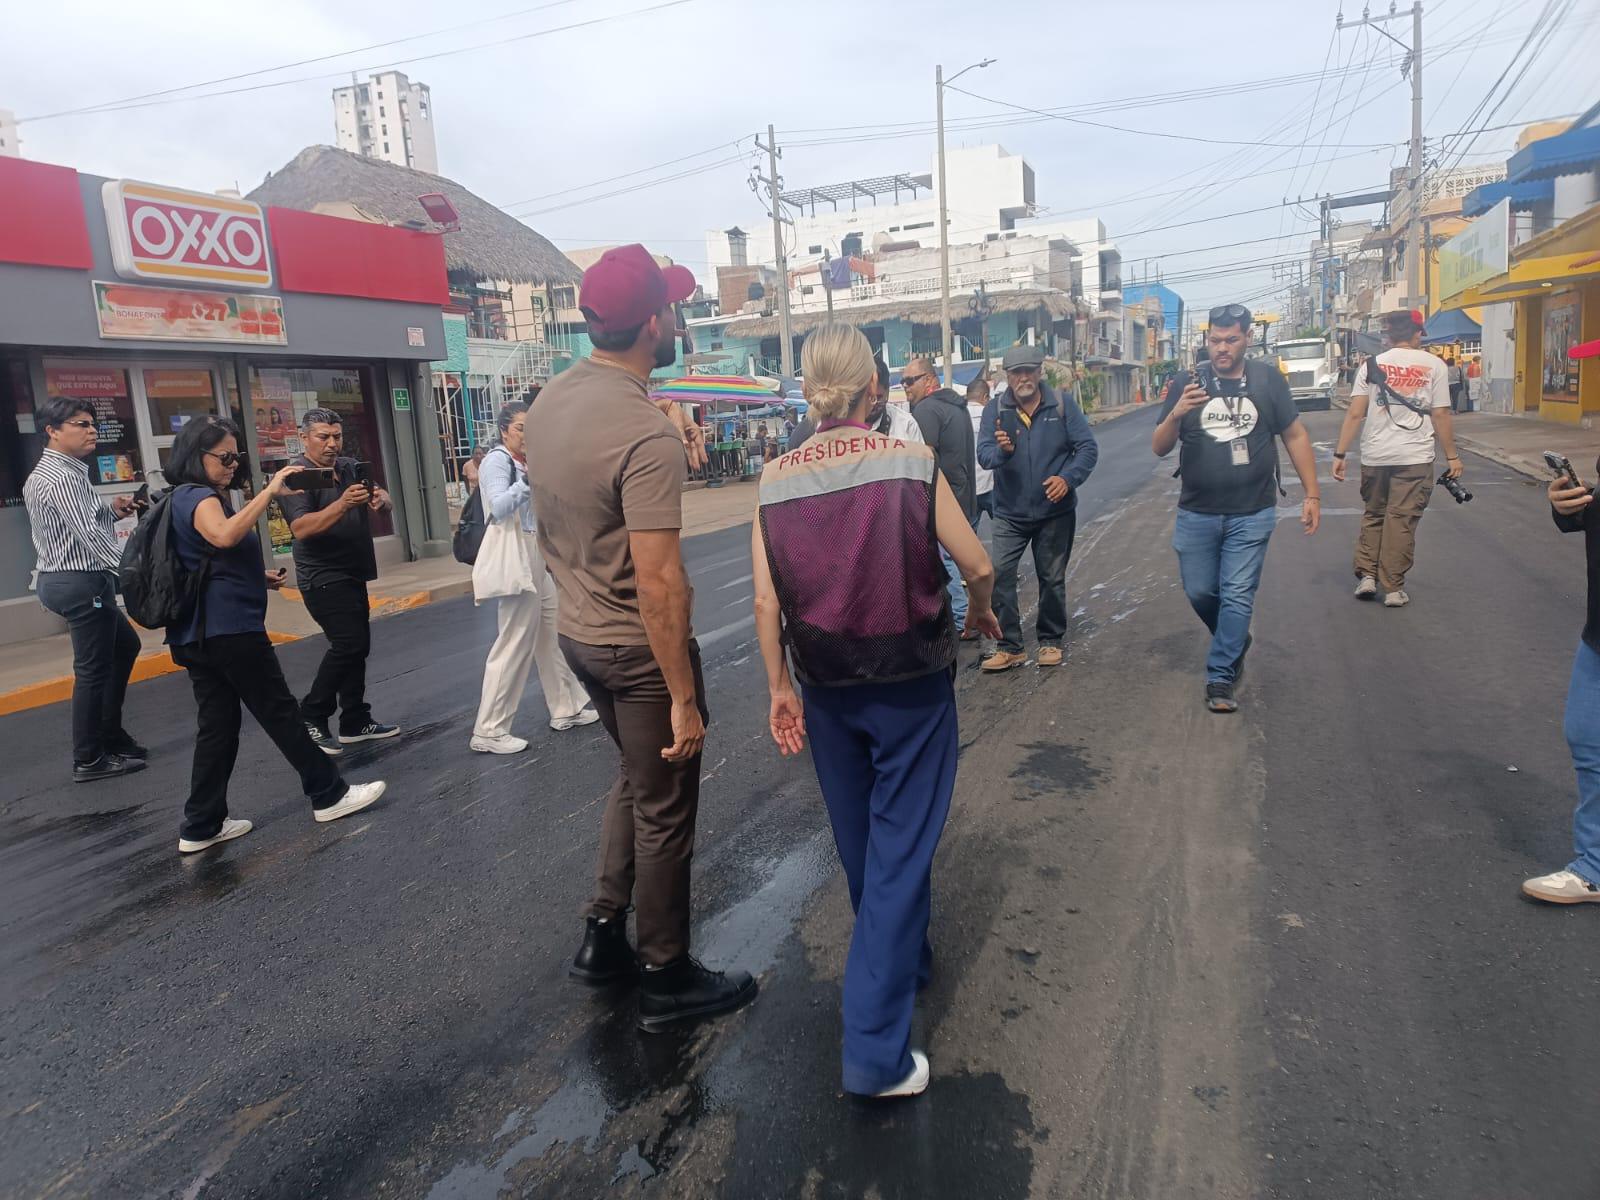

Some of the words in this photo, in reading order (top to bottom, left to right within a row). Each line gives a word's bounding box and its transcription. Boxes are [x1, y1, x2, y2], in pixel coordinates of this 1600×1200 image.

[132, 205, 262, 266] OXXO
[1208, 413, 1251, 421] PUNTO
[779, 437, 906, 470] PRESIDENTA
